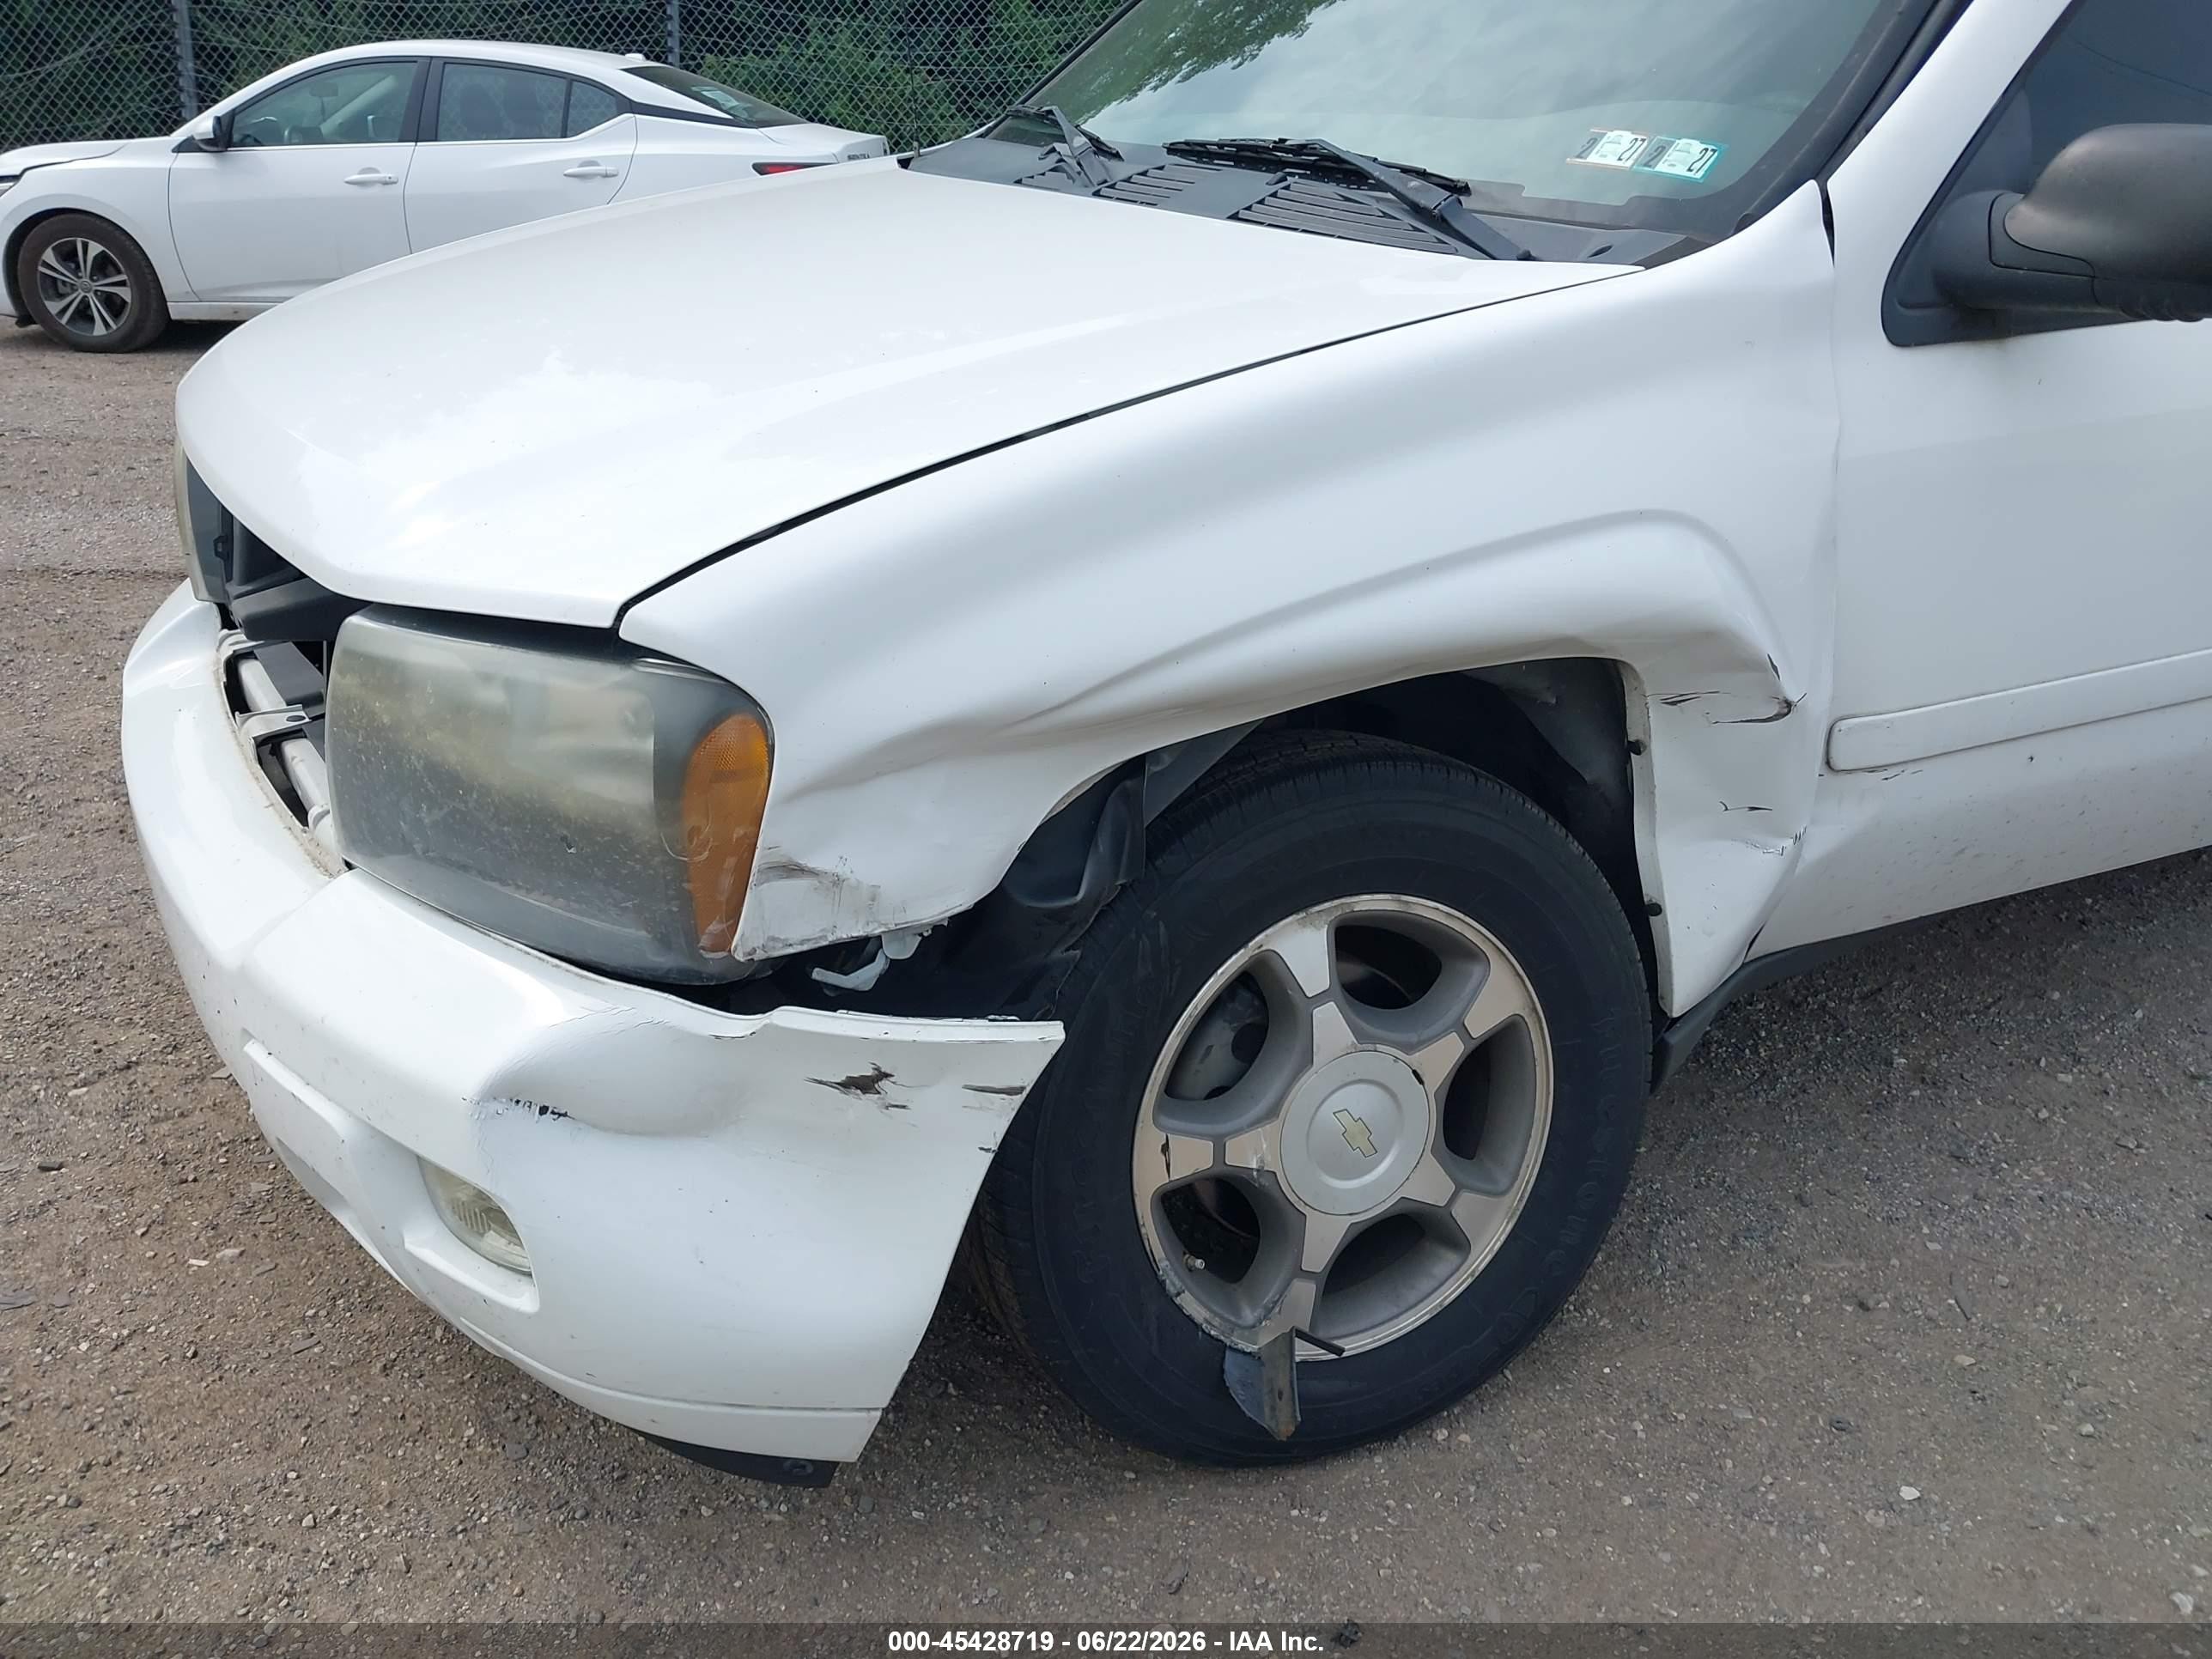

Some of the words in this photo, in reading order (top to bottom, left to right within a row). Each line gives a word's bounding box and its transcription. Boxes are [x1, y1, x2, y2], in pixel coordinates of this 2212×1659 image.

[1617, 137, 1647, 161] 27
[1644, 145, 1667, 168] 2
[1686, 147, 1718, 175] 27
